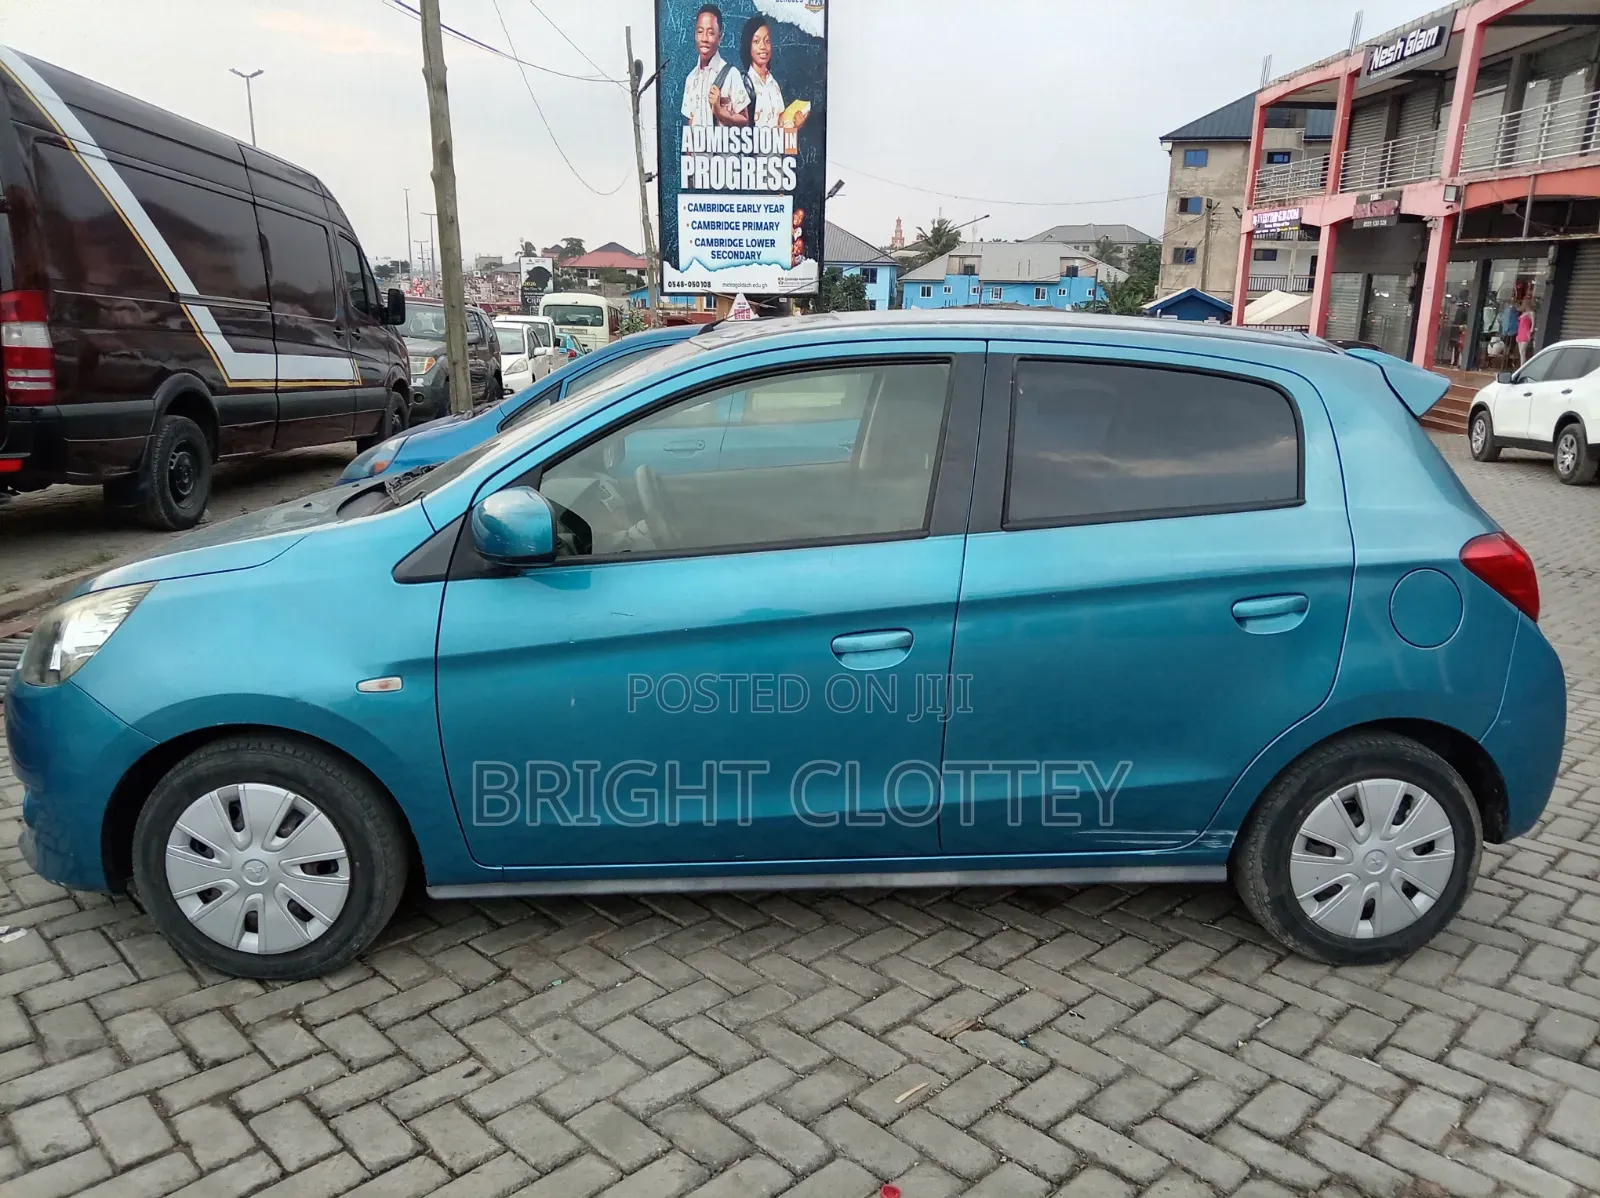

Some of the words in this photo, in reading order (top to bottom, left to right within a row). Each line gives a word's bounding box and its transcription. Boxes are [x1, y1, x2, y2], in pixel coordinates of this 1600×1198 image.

[1370, 37, 1405, 71] Nesh
[1403, 25, 1440, 57] Glam
[681, 126, 785, 154] ADMISSION
[784, 131, 798, 150] IN
[680, 155, 798, 191] PROGRESS
[687, 203, 735, 213] CAMBRIDGE
[736, 203, 761, 213] EARLY
[763, 204, 785, 213] YEAR
[691, 220, 741, 231] CAMBRIDGE
[742, 221, 781, 231] PRIMARY
[694, 238, 744, 248] CAMBRIDGE
[745, 238, 776, 248] LOWER
[710, 250, 762, 260] SECONDARY
